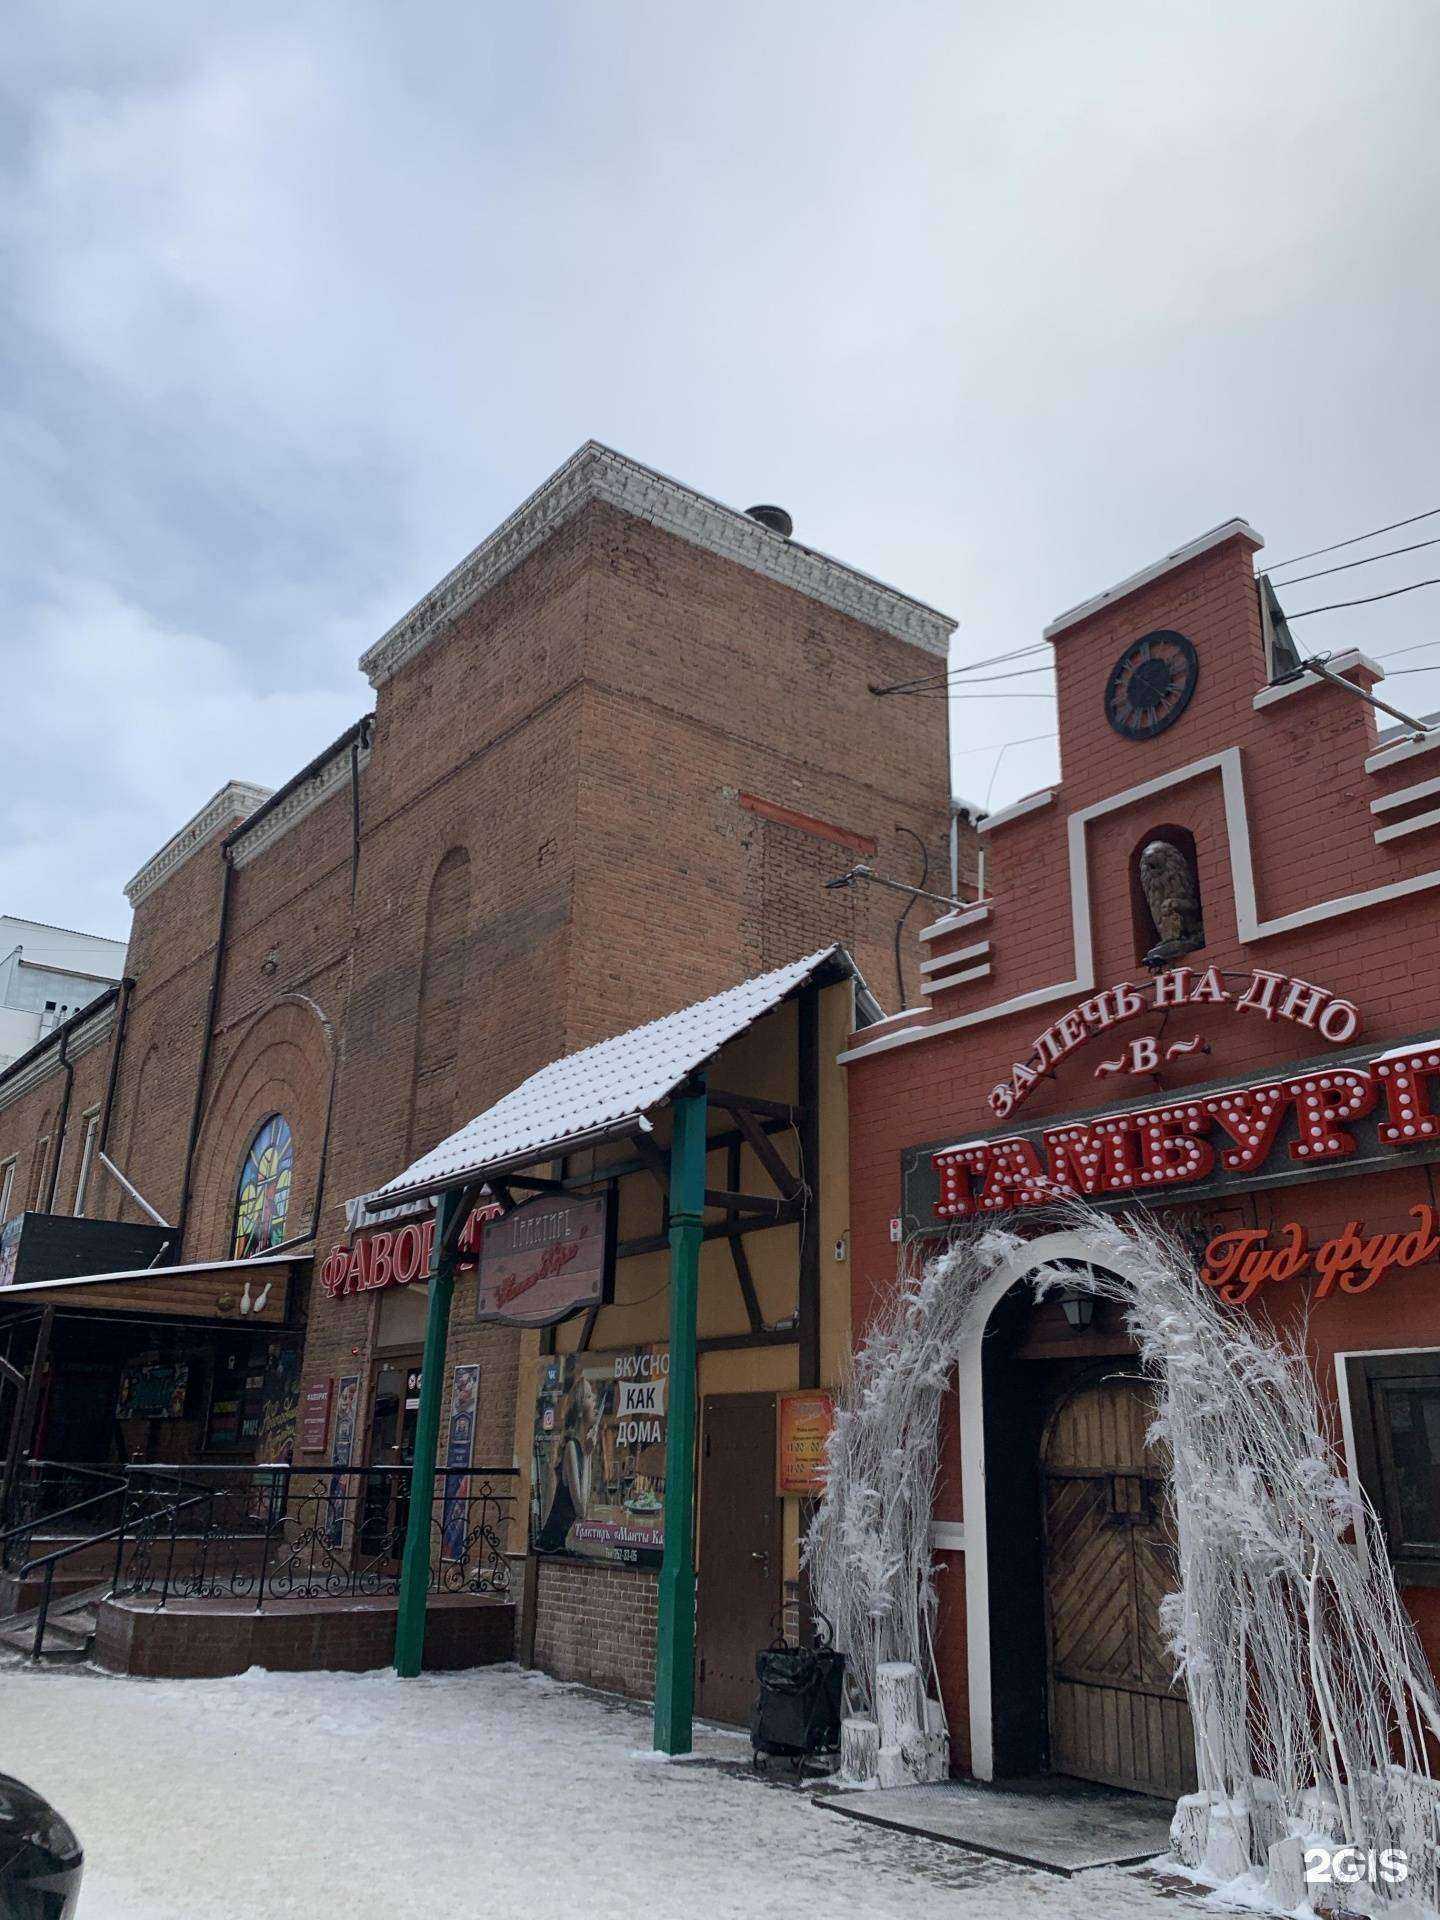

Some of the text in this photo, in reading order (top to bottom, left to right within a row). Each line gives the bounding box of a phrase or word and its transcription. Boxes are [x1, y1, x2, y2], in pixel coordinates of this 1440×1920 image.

[987, 965, 1362, 1119] ЗАЛЕЧЬ НА ДНО
[1129, 1035, 1161, 1074] В
[1314, 1203, 1440, 1298] фуд
[614, 1353, 669, 1378] ВКУСНО
[626, 1387, 656, 1410] КАК
[616, 1420, 661, 1448] ДОМА
